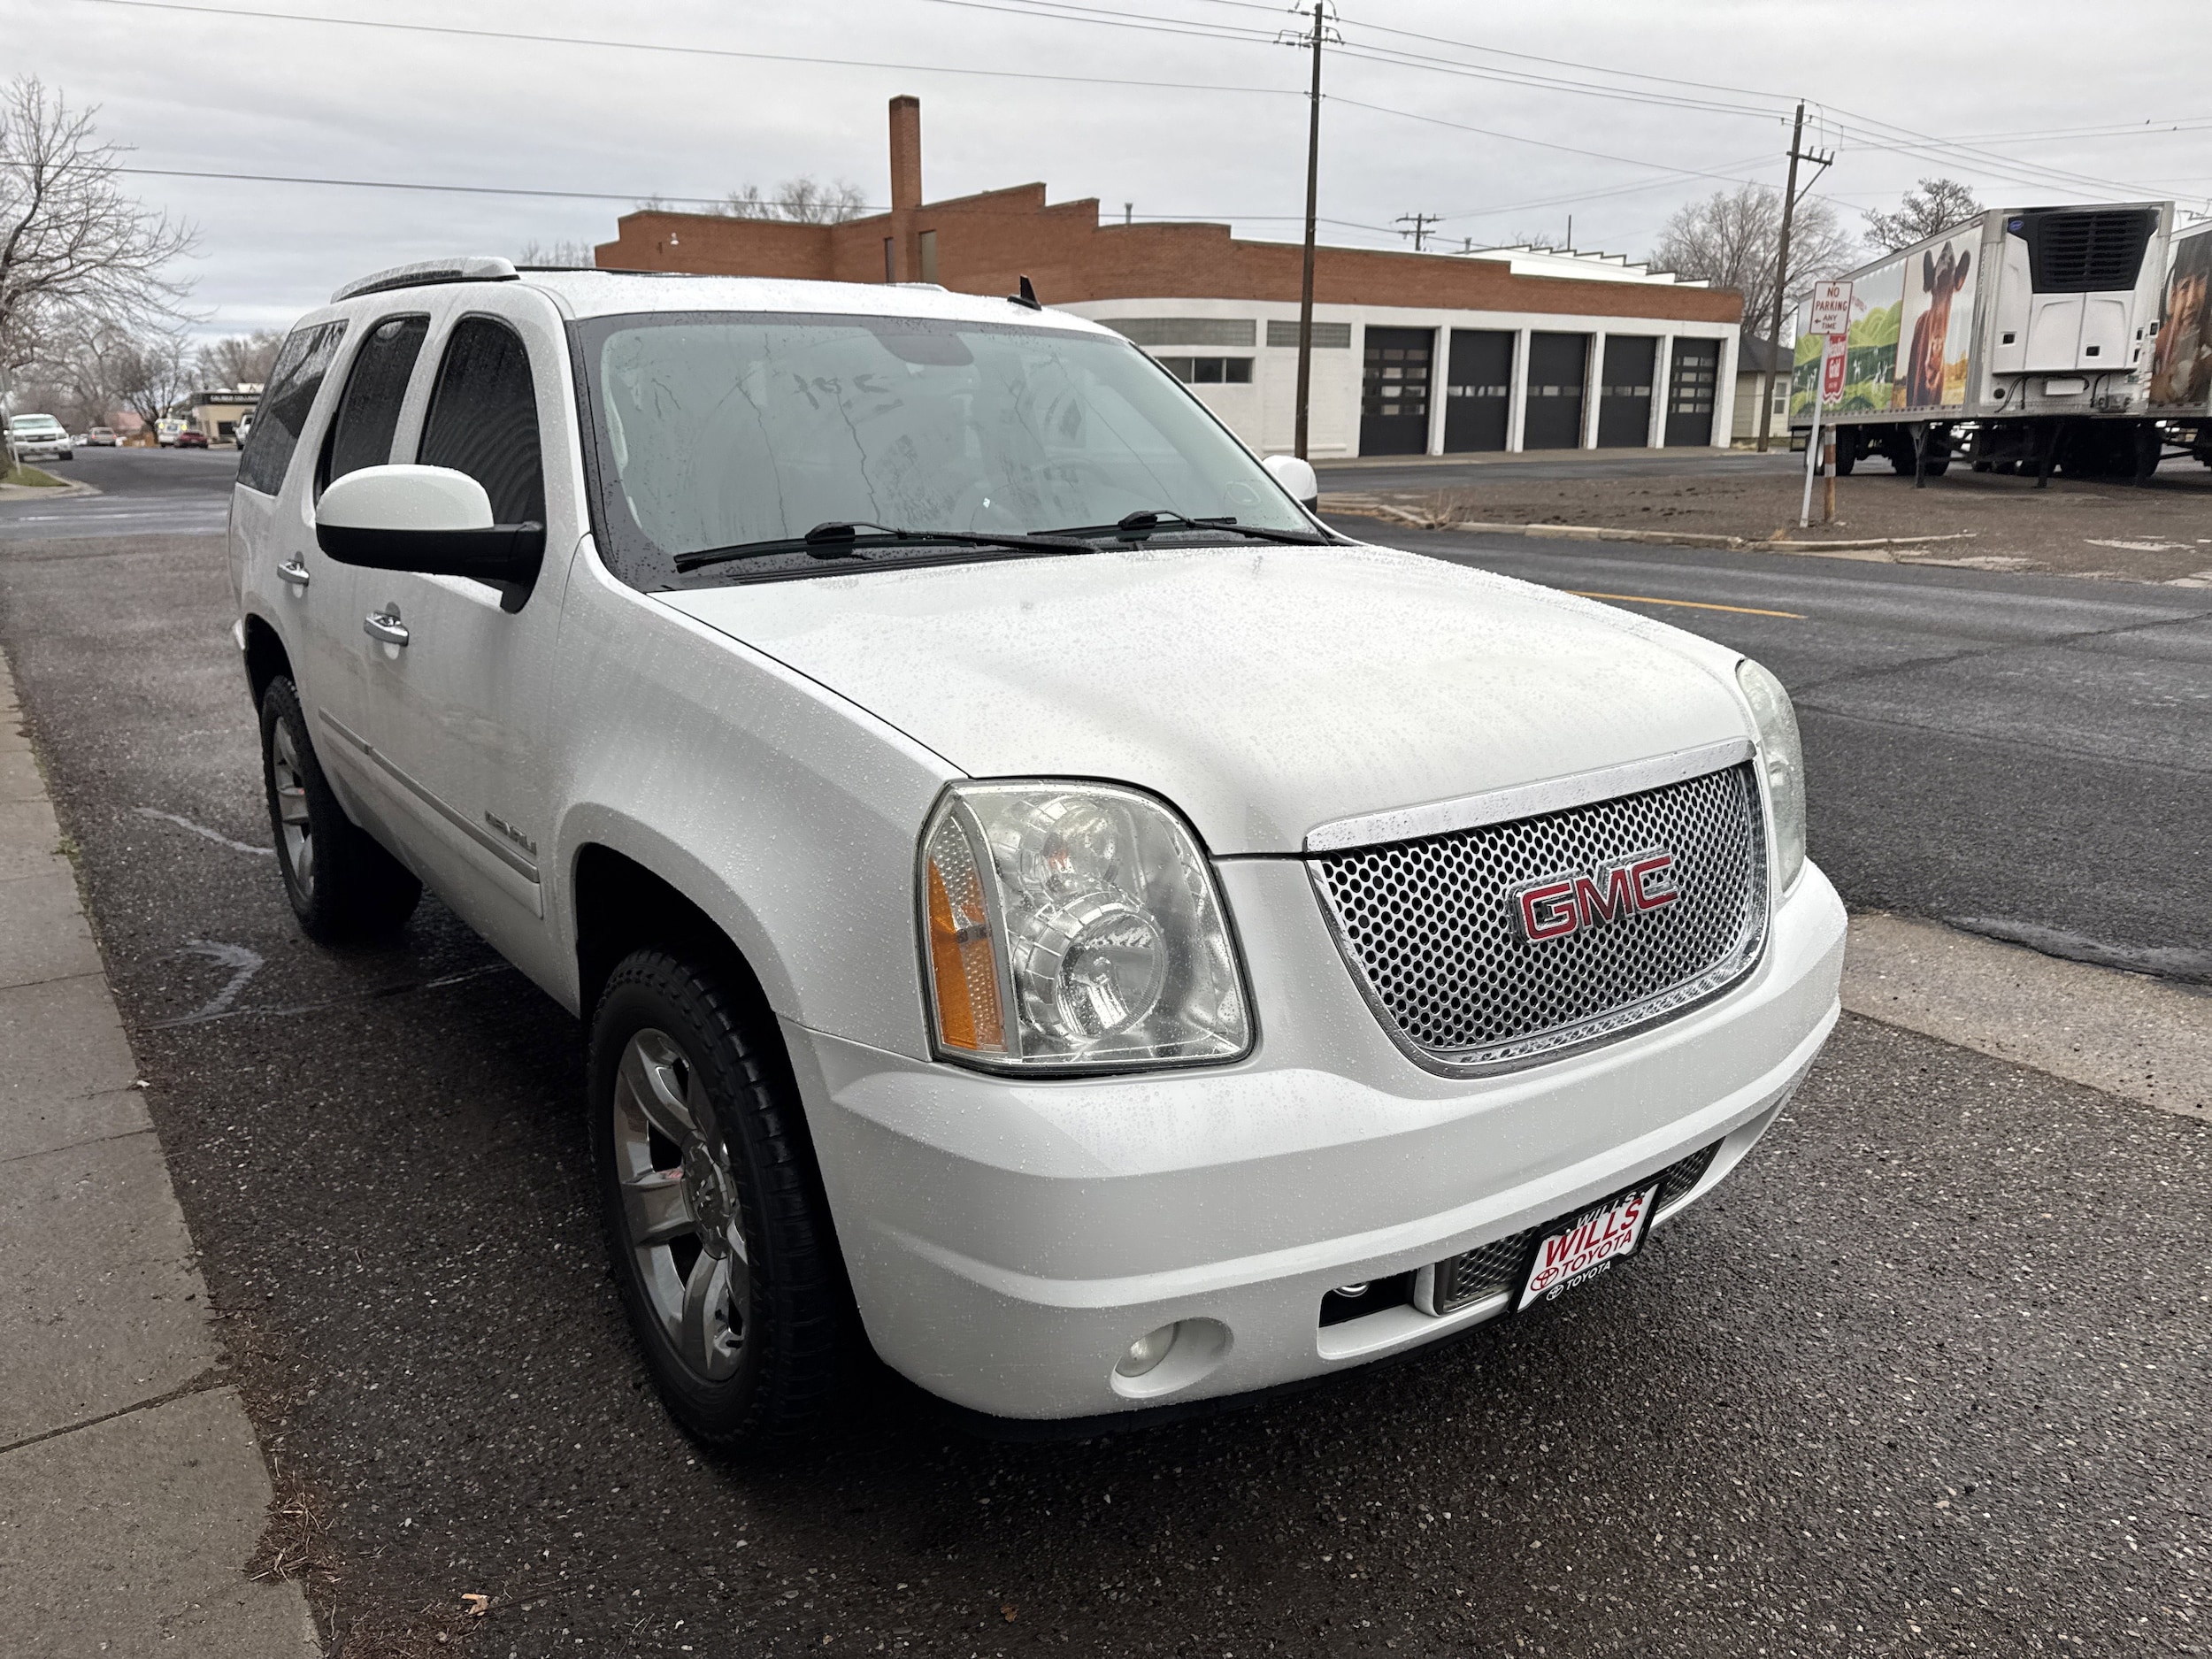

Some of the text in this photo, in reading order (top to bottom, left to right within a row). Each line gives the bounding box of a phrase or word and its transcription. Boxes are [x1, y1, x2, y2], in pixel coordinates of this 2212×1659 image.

[1816, 300, 1847, 311] PARKING
[1827, 287, 1840, 298] NO
[1514, 850, 1679, 943] GMC
[1545, 1198, 1644, 1268] WILLS
[1561, 1229, 1632, 1278] TOYOTA
[1566, 1260, 1611, 1291] TOYOTA
